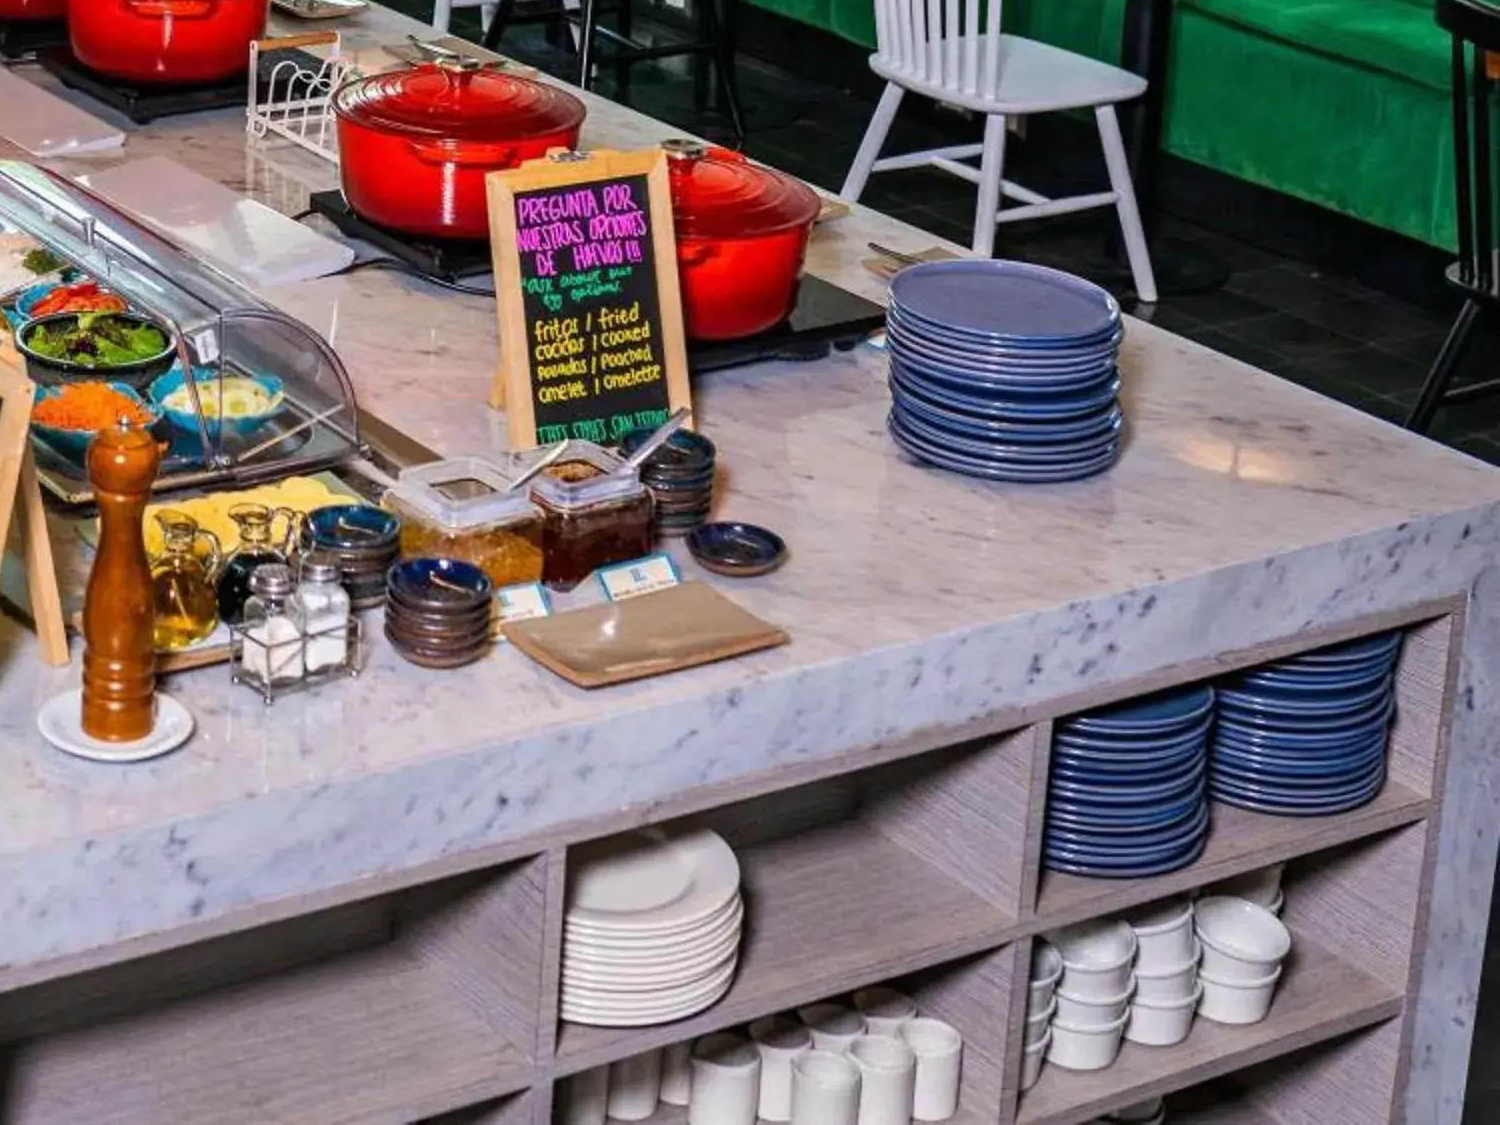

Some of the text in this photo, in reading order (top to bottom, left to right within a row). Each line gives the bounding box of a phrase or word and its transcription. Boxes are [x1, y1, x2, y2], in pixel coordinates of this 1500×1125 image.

[518, 185, 638, 224] PREGUNTA POR
[516, 210, 647, 253] NUESTRAS OPCIONES
[535, 250, 557, 276] DE
[597, 301, 639, 330] fried
